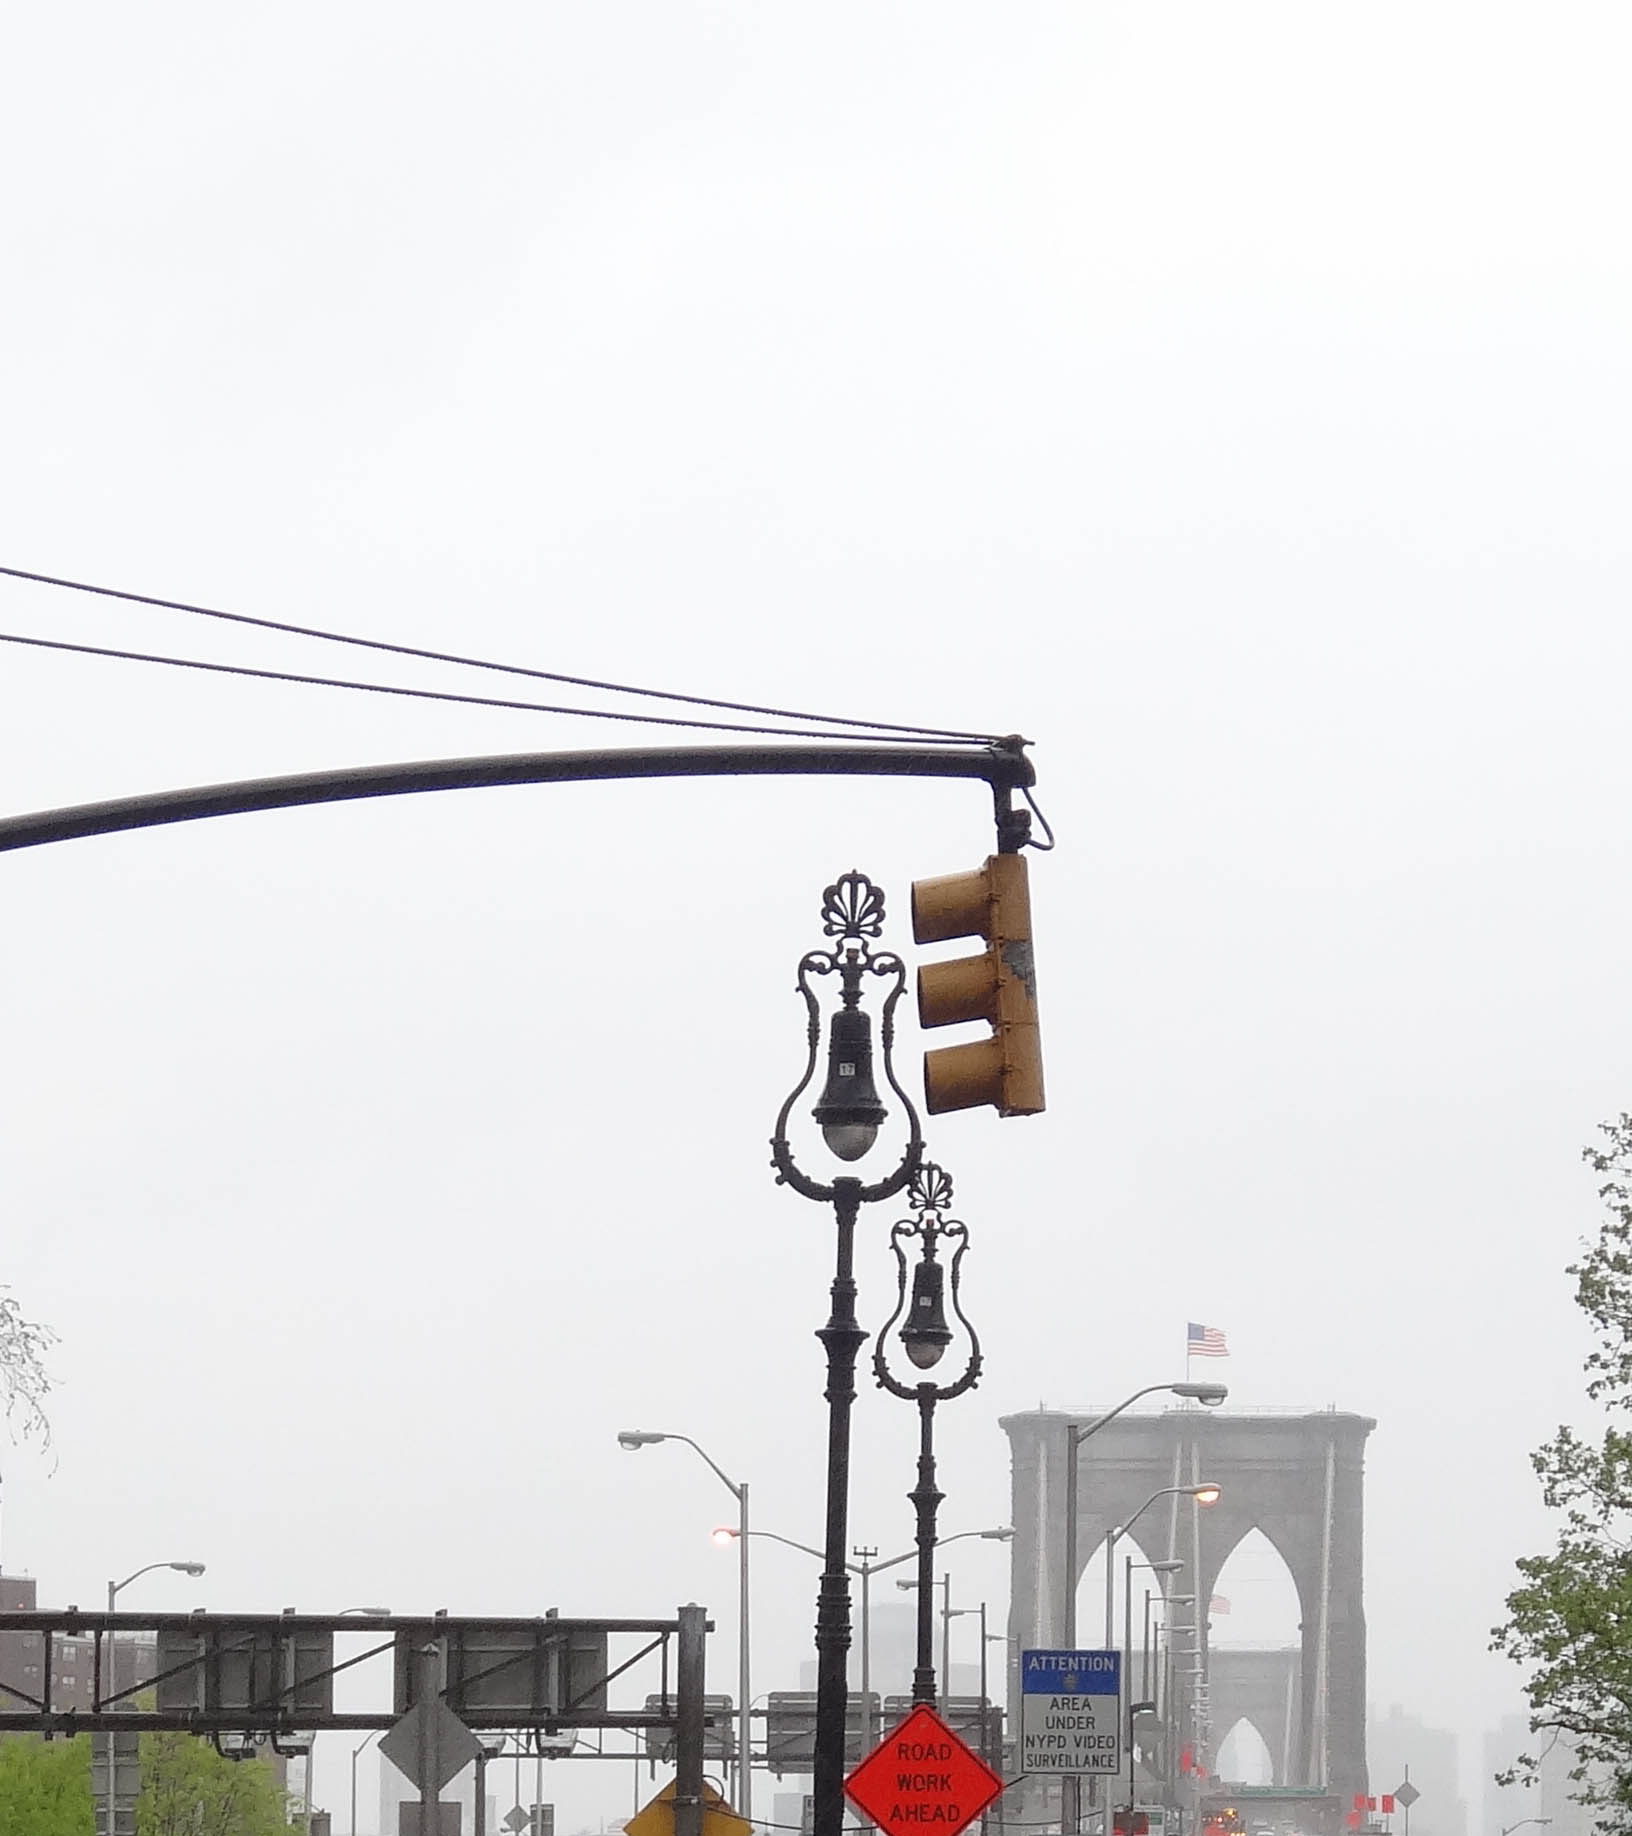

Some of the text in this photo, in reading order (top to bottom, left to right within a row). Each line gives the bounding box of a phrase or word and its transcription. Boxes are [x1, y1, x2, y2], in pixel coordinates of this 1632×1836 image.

[1029, 1656, 1114, 1671] ATTENTION
[1049, 1697, 1092, 1711] AREA
[1045, 1715, 1096, 1730] UNDER
[1025, 1734, 1116, 1749] NYPD VIDEO
[897, 1743, 952, 1761] ROAD
[1026, 1753, 1116, 1768] SURVEILLANCE
[897, 1774, 952, 1792] WORK
[889, 1804, 961, 1823] AHEAD
